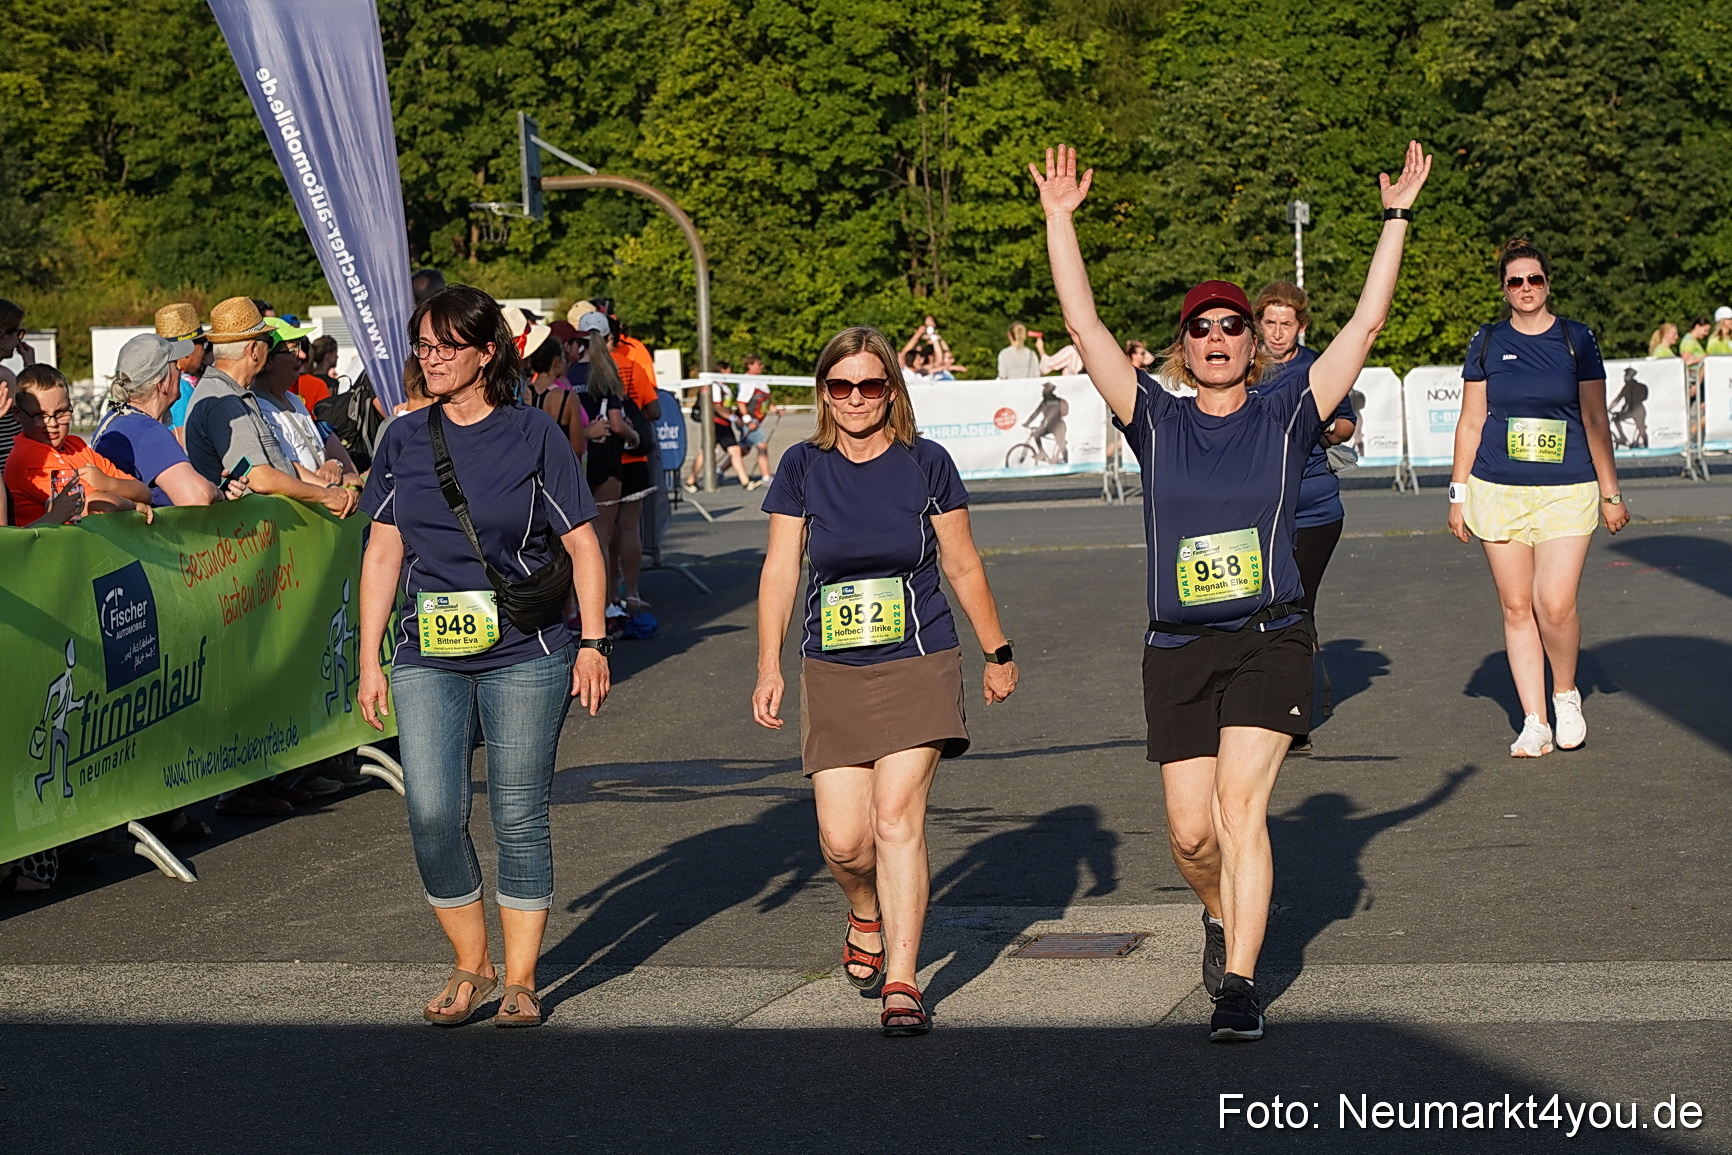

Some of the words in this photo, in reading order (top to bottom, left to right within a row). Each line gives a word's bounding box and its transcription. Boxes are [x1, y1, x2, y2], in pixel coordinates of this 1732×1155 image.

[1518, 433, 1556, 448] 1265
[180, 528, 237, 589] Gesunde
[233, 519, 279, 560] Firmen
[1194, 555, 1242, 582] 958
[1180, 566, 1191, 597] WALK
[1250, 555, 1260, 585] 2022
[217, 576, 256, 627] laufen
[256, 547, 299, 611] länger!
[1194, 581, 1228, 593] Regnath
[1230, 578, 1249, 587] Elke
[109, 600, 148, 630] Fischer
[435, 614, 477, 636] 948
[825, 610, 833, 642] WALK
[839, 602, 884, 627] 952
[868, 625, 892, 633] Ulrike
[893, 603, 901, 633] 2022
[116, 620, 147, 640] AUTOMOBILE
[422, 618, 431, 648] WALK
[437, 637, 462, 645] Bittner
[463, 636, 479, 644] Eva
[486, 616, 496, 644] 2022
[80, 635, 207, 758] firmenlauf
[79, 738, 137, 787] neumarkt
[162, 715, 300, 790] www.firmenlauf-oberpfalz.de
